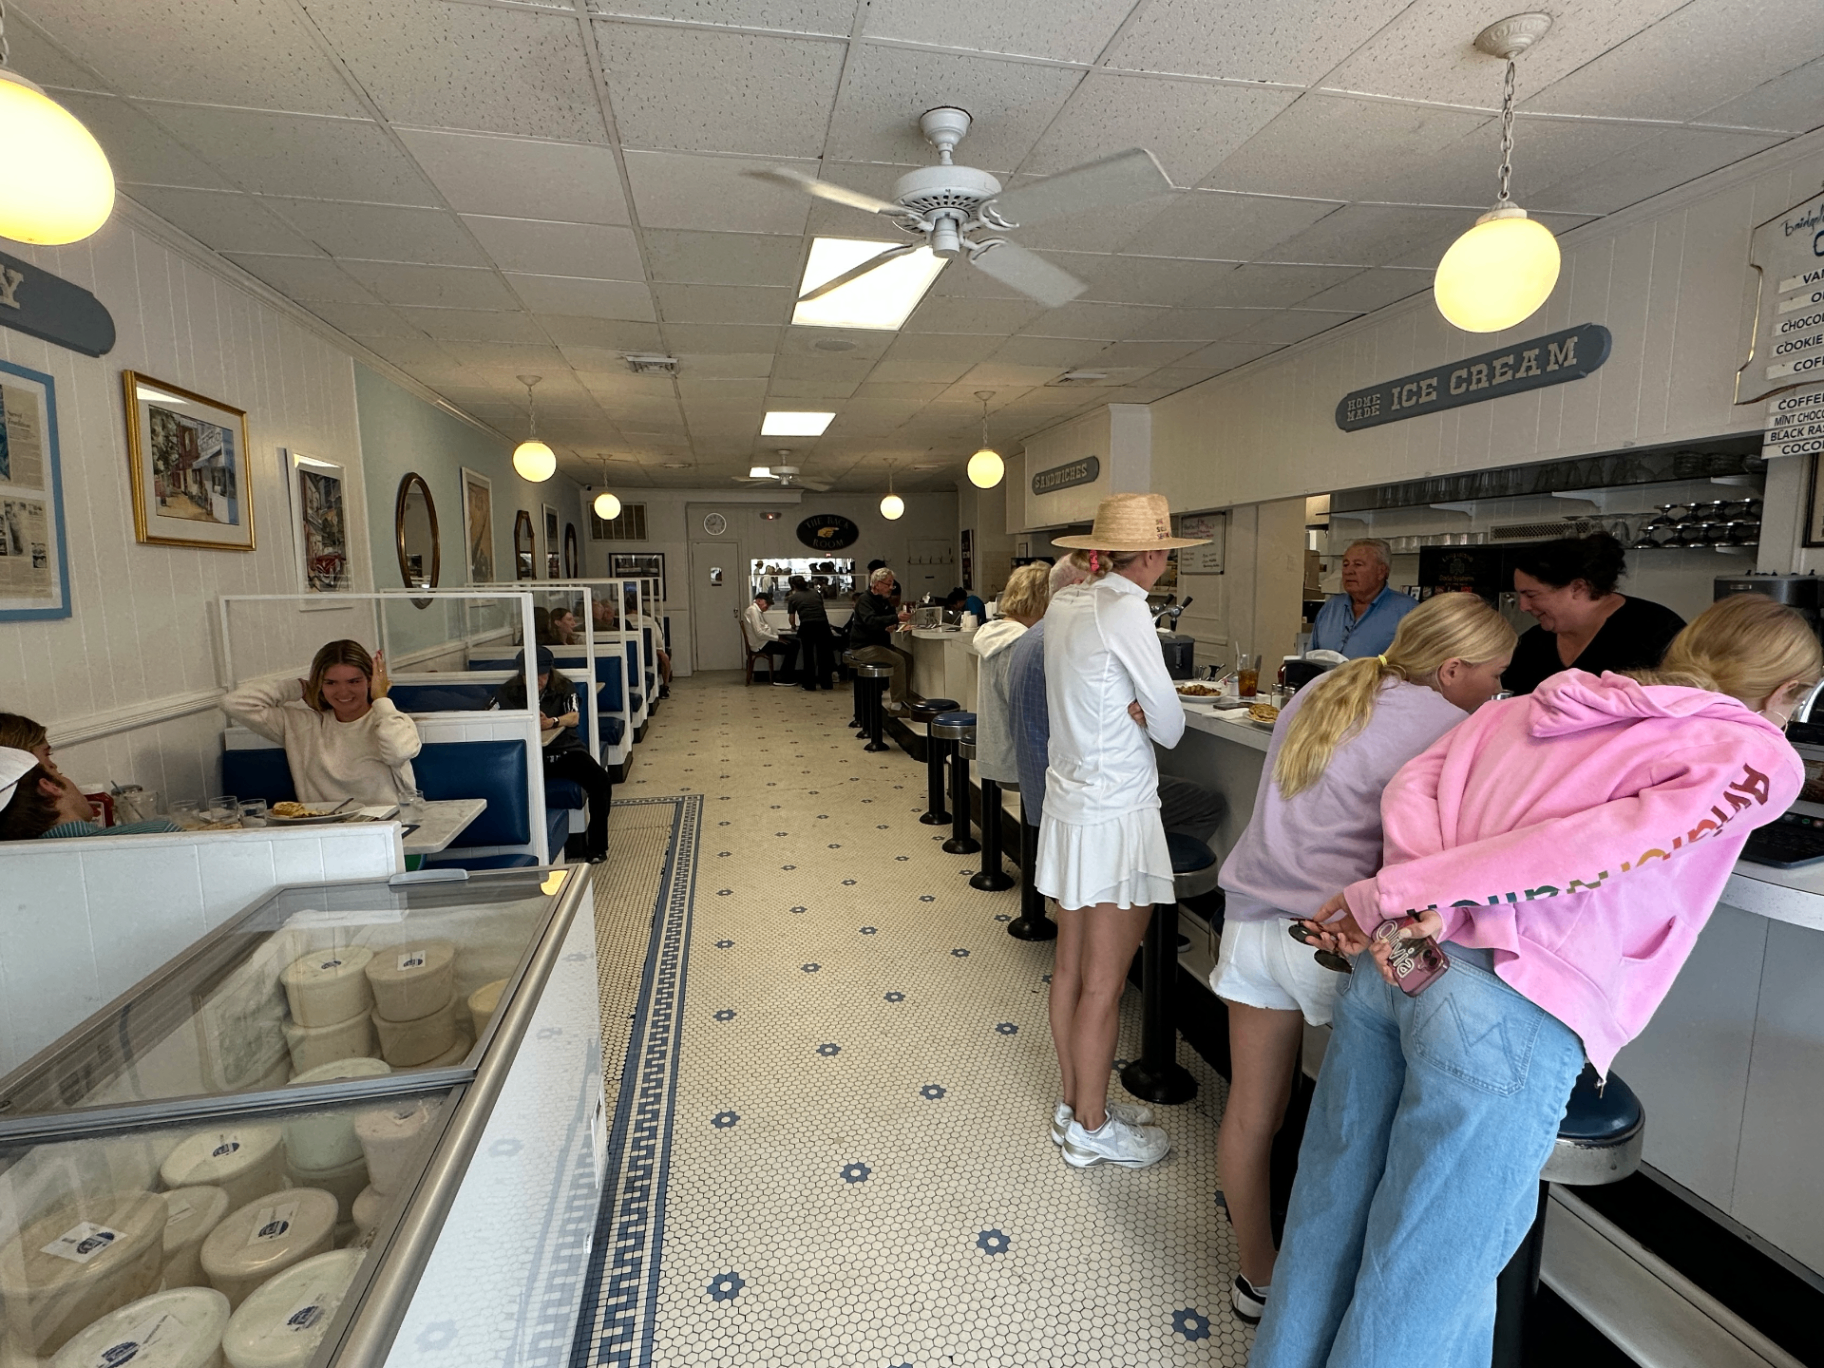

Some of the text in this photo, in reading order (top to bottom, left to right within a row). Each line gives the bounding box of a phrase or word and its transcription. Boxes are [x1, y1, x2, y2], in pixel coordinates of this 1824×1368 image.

[1776, 334, 1823, 355] COOKIE
[1391, 336, 1578, 411] ICE CREAM
[1347, 393, 1381, 411] HOME
[1347, 405, 1380, 422] MADE
[1774, 414, 1796, 427] MINT
[1770, 427, 1805, 442] BLACK
[1035, 463, 1088, 488] SANDWICHES
[806, 516, 849, 529] THE BACK
[813, 538, 844, 548] ROOM
